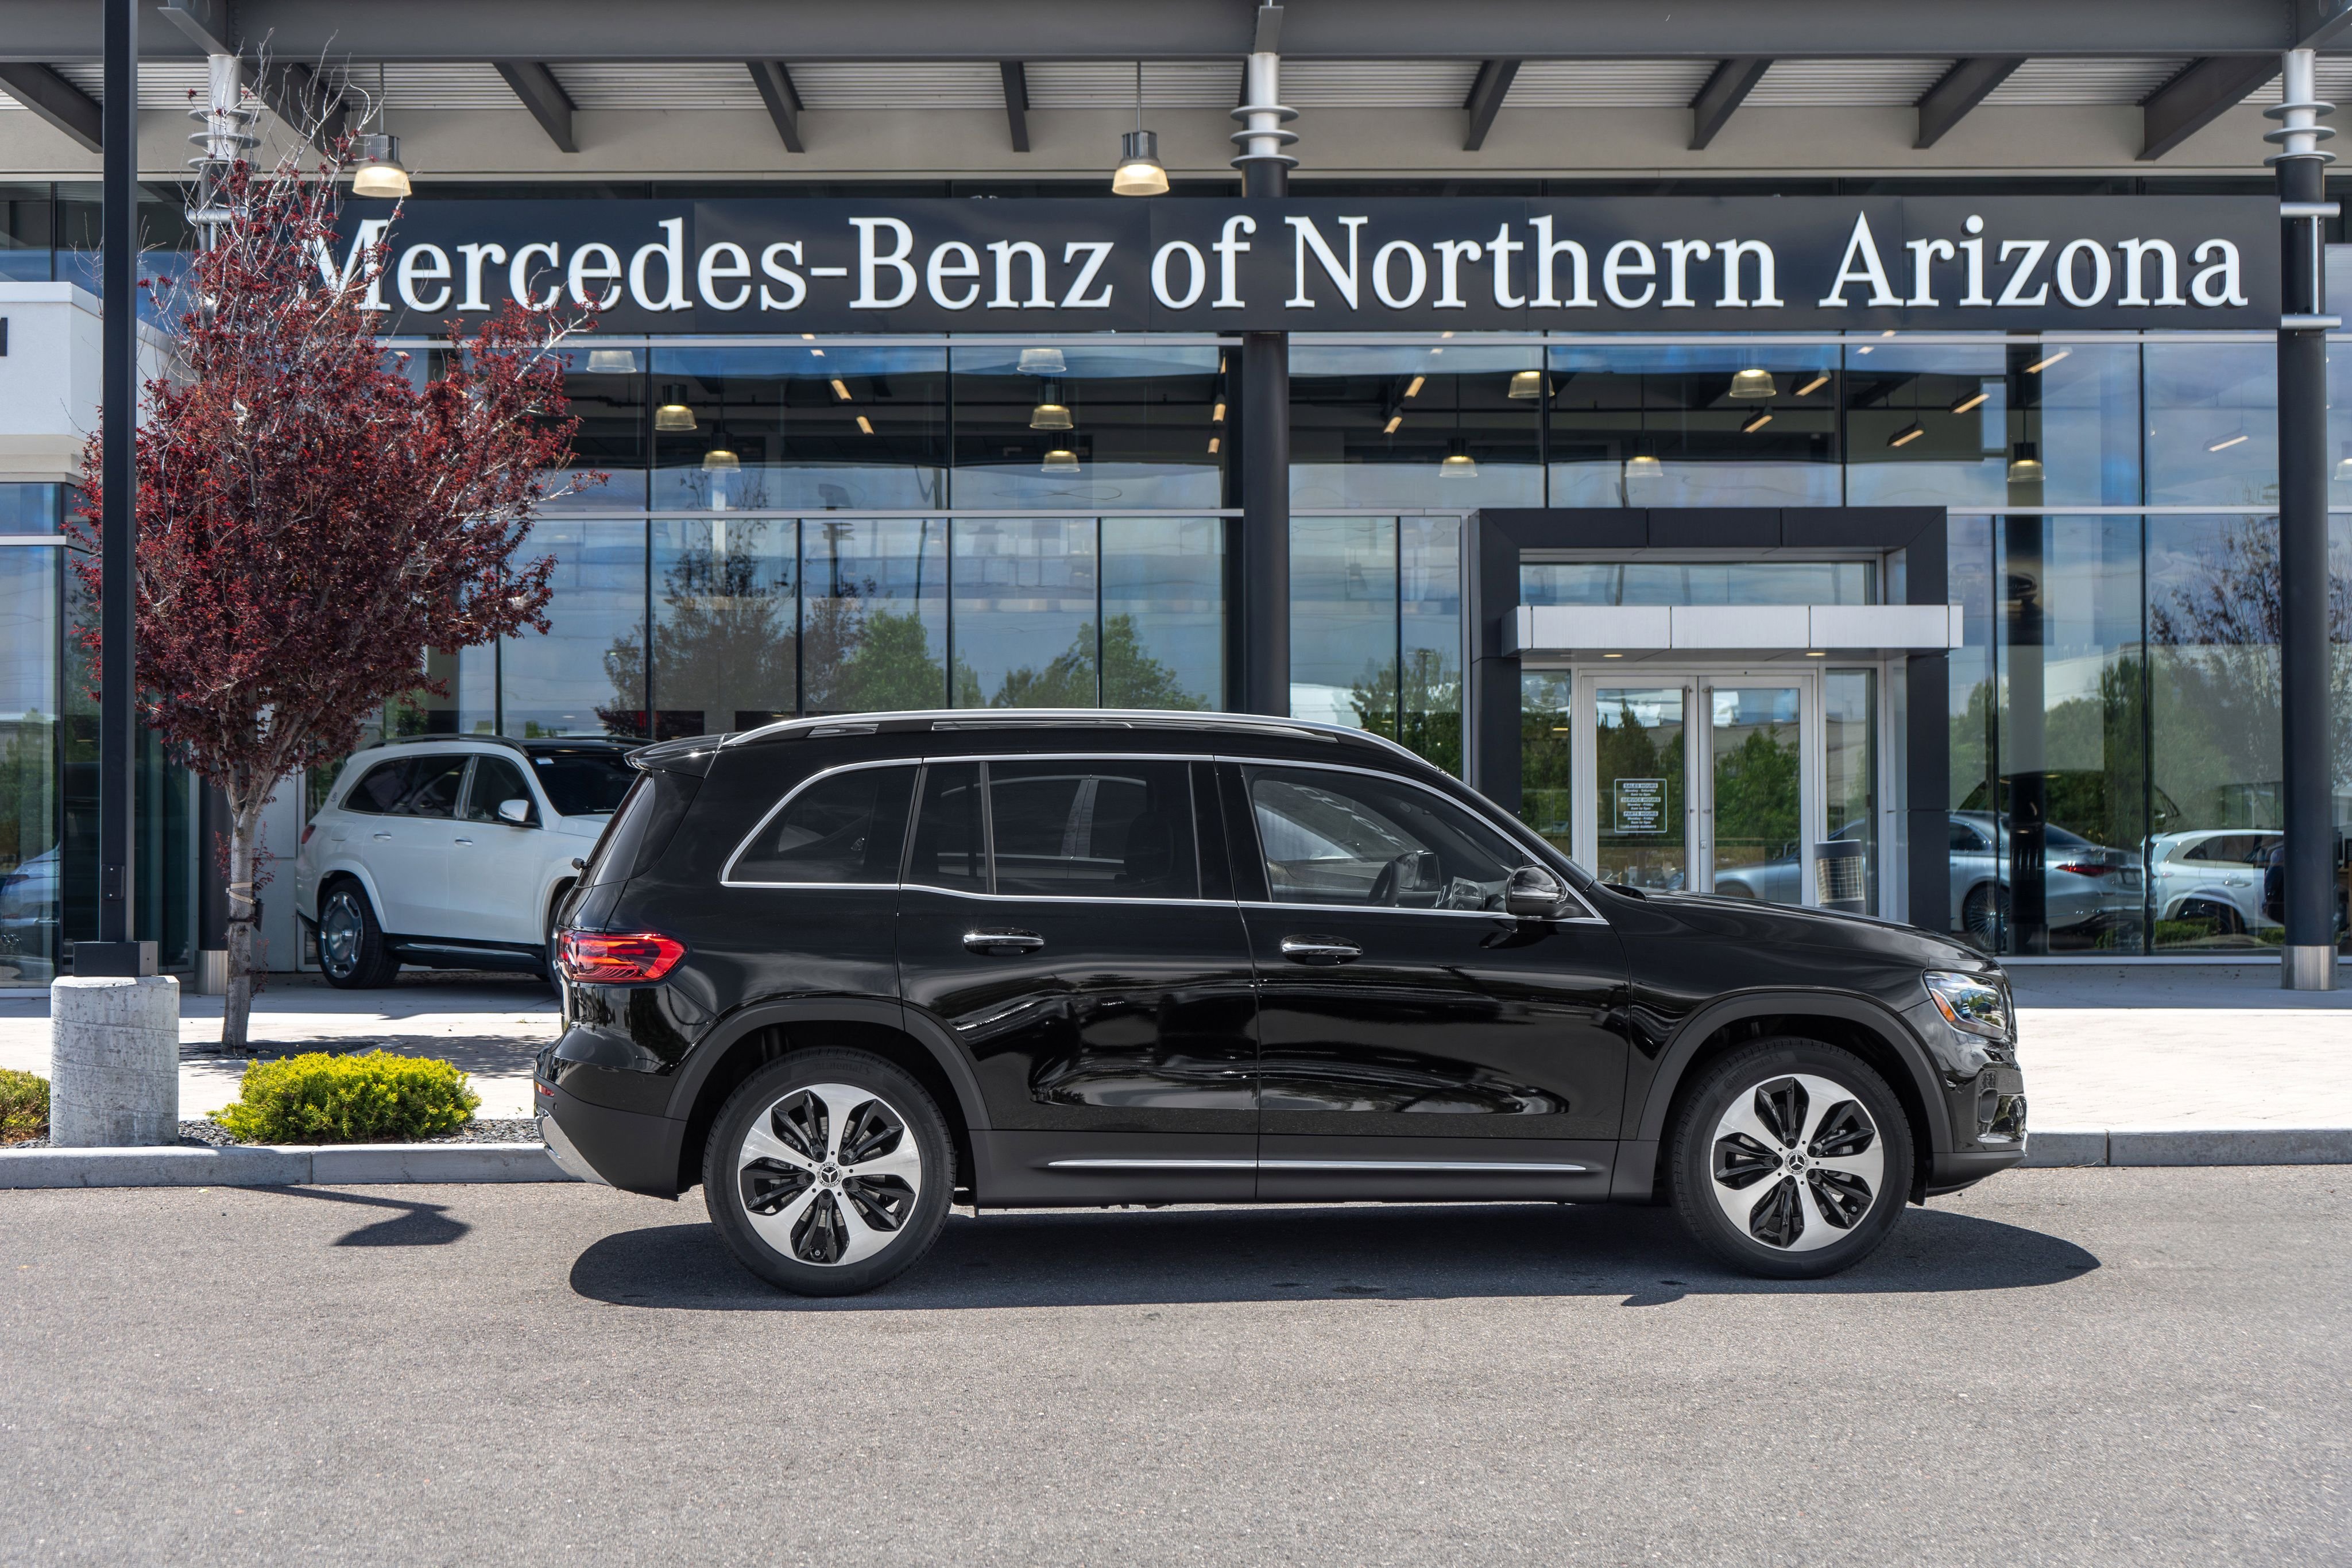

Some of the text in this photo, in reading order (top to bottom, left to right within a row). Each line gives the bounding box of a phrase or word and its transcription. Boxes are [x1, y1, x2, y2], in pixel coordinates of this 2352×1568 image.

[293, 210, 2248, 312] Mercedes-Benz of Northern Arizona
